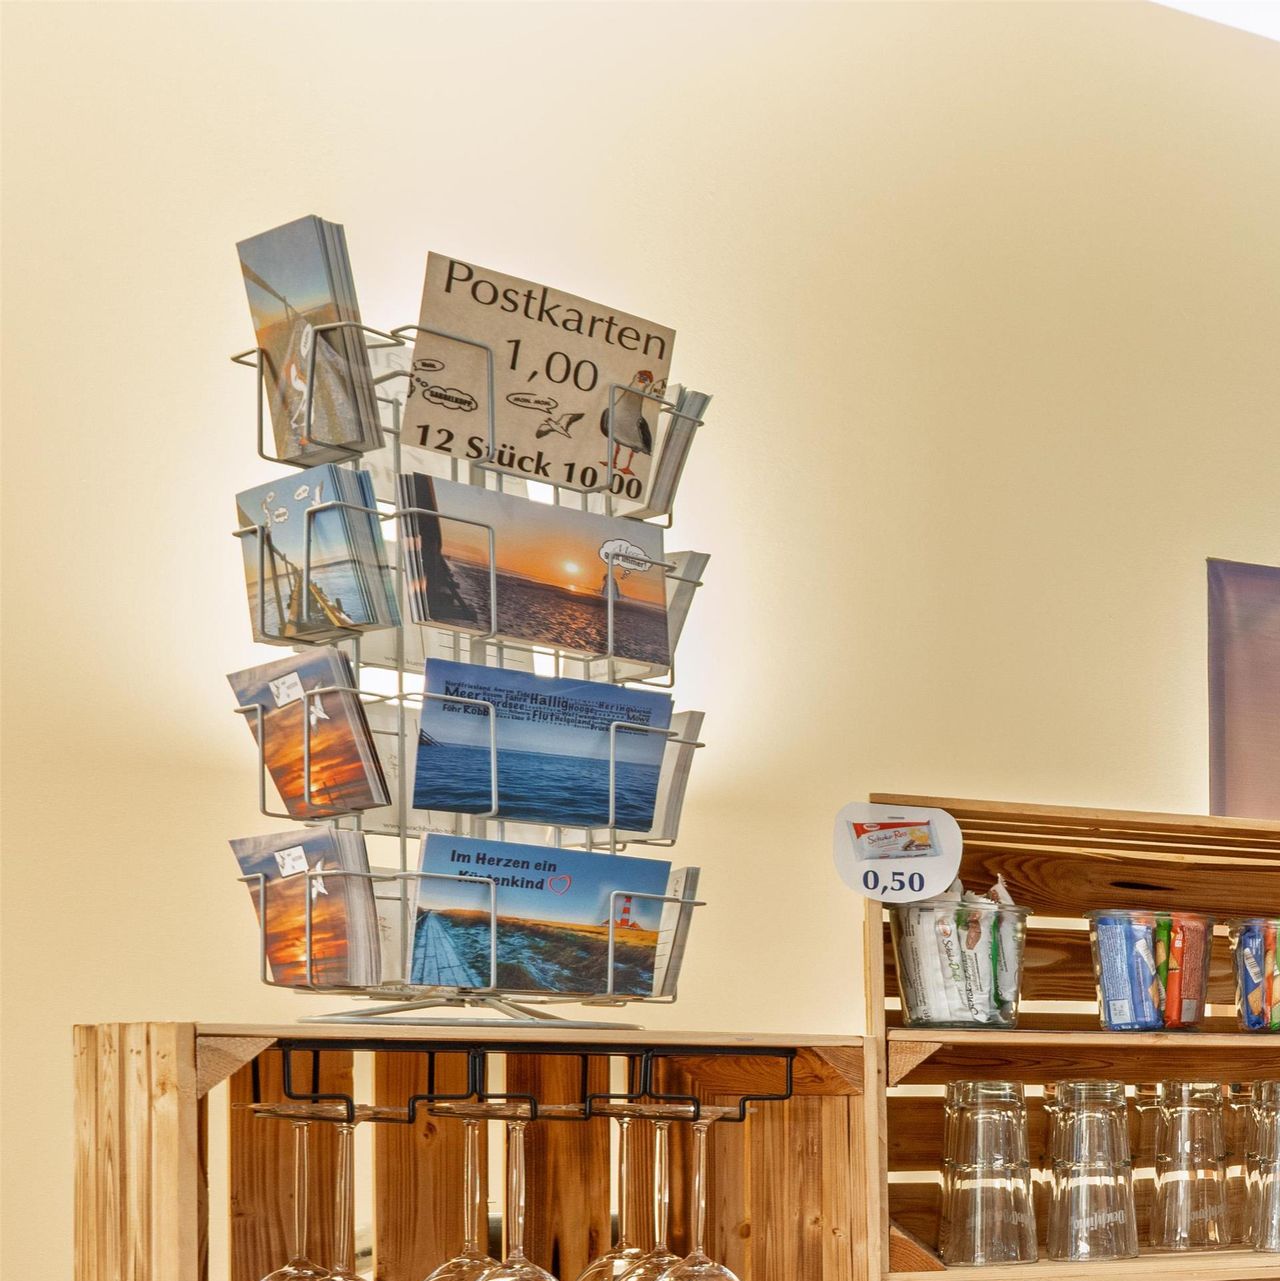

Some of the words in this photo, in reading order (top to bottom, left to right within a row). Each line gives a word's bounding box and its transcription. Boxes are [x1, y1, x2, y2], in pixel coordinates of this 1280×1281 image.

[445, 259, 667, 360] Postkarten
[507, 339, 598, 391] 1,00
[416, 424, 454, 452] 12
[564, 462, 643, 499] 1000
[445, 686, 480, 701] Meer
[529, 692, 568, 711] Hallig
[532, 710, 555, 722] Flut
[451, 850, 470, 863] Im
[476, 852, 530, 869] Herzen
[533, 859, 558, 873] ein
[862, 870, 925, 895] 0,50
